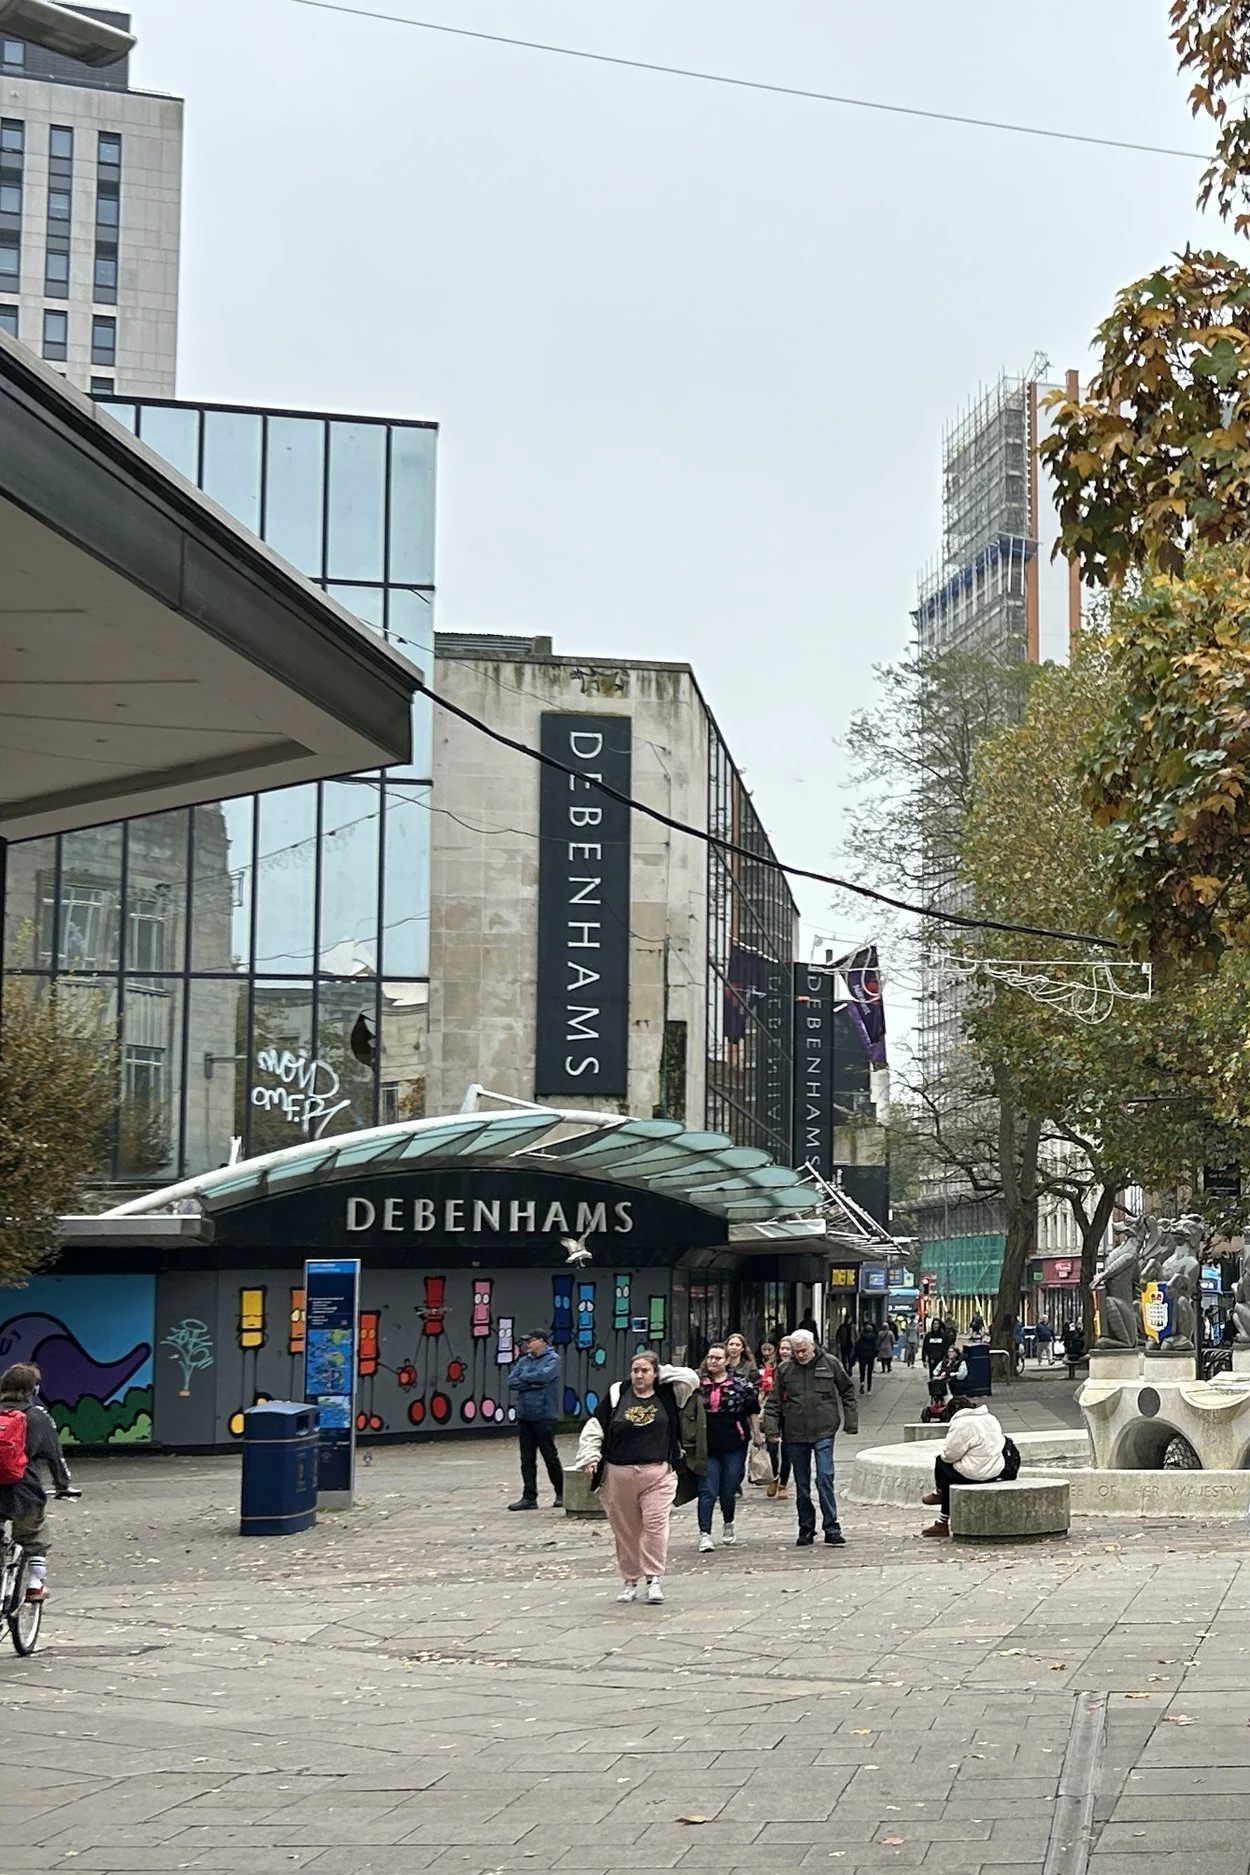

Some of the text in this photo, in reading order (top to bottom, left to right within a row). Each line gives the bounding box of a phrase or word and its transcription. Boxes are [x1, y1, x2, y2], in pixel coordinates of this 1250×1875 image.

[564, 730, 604, 1076] DEBENHAMS
[806, 975, 822, 1167] DEBENHAMS
[346, 1197, 633, 1233] DEBENHAMS
